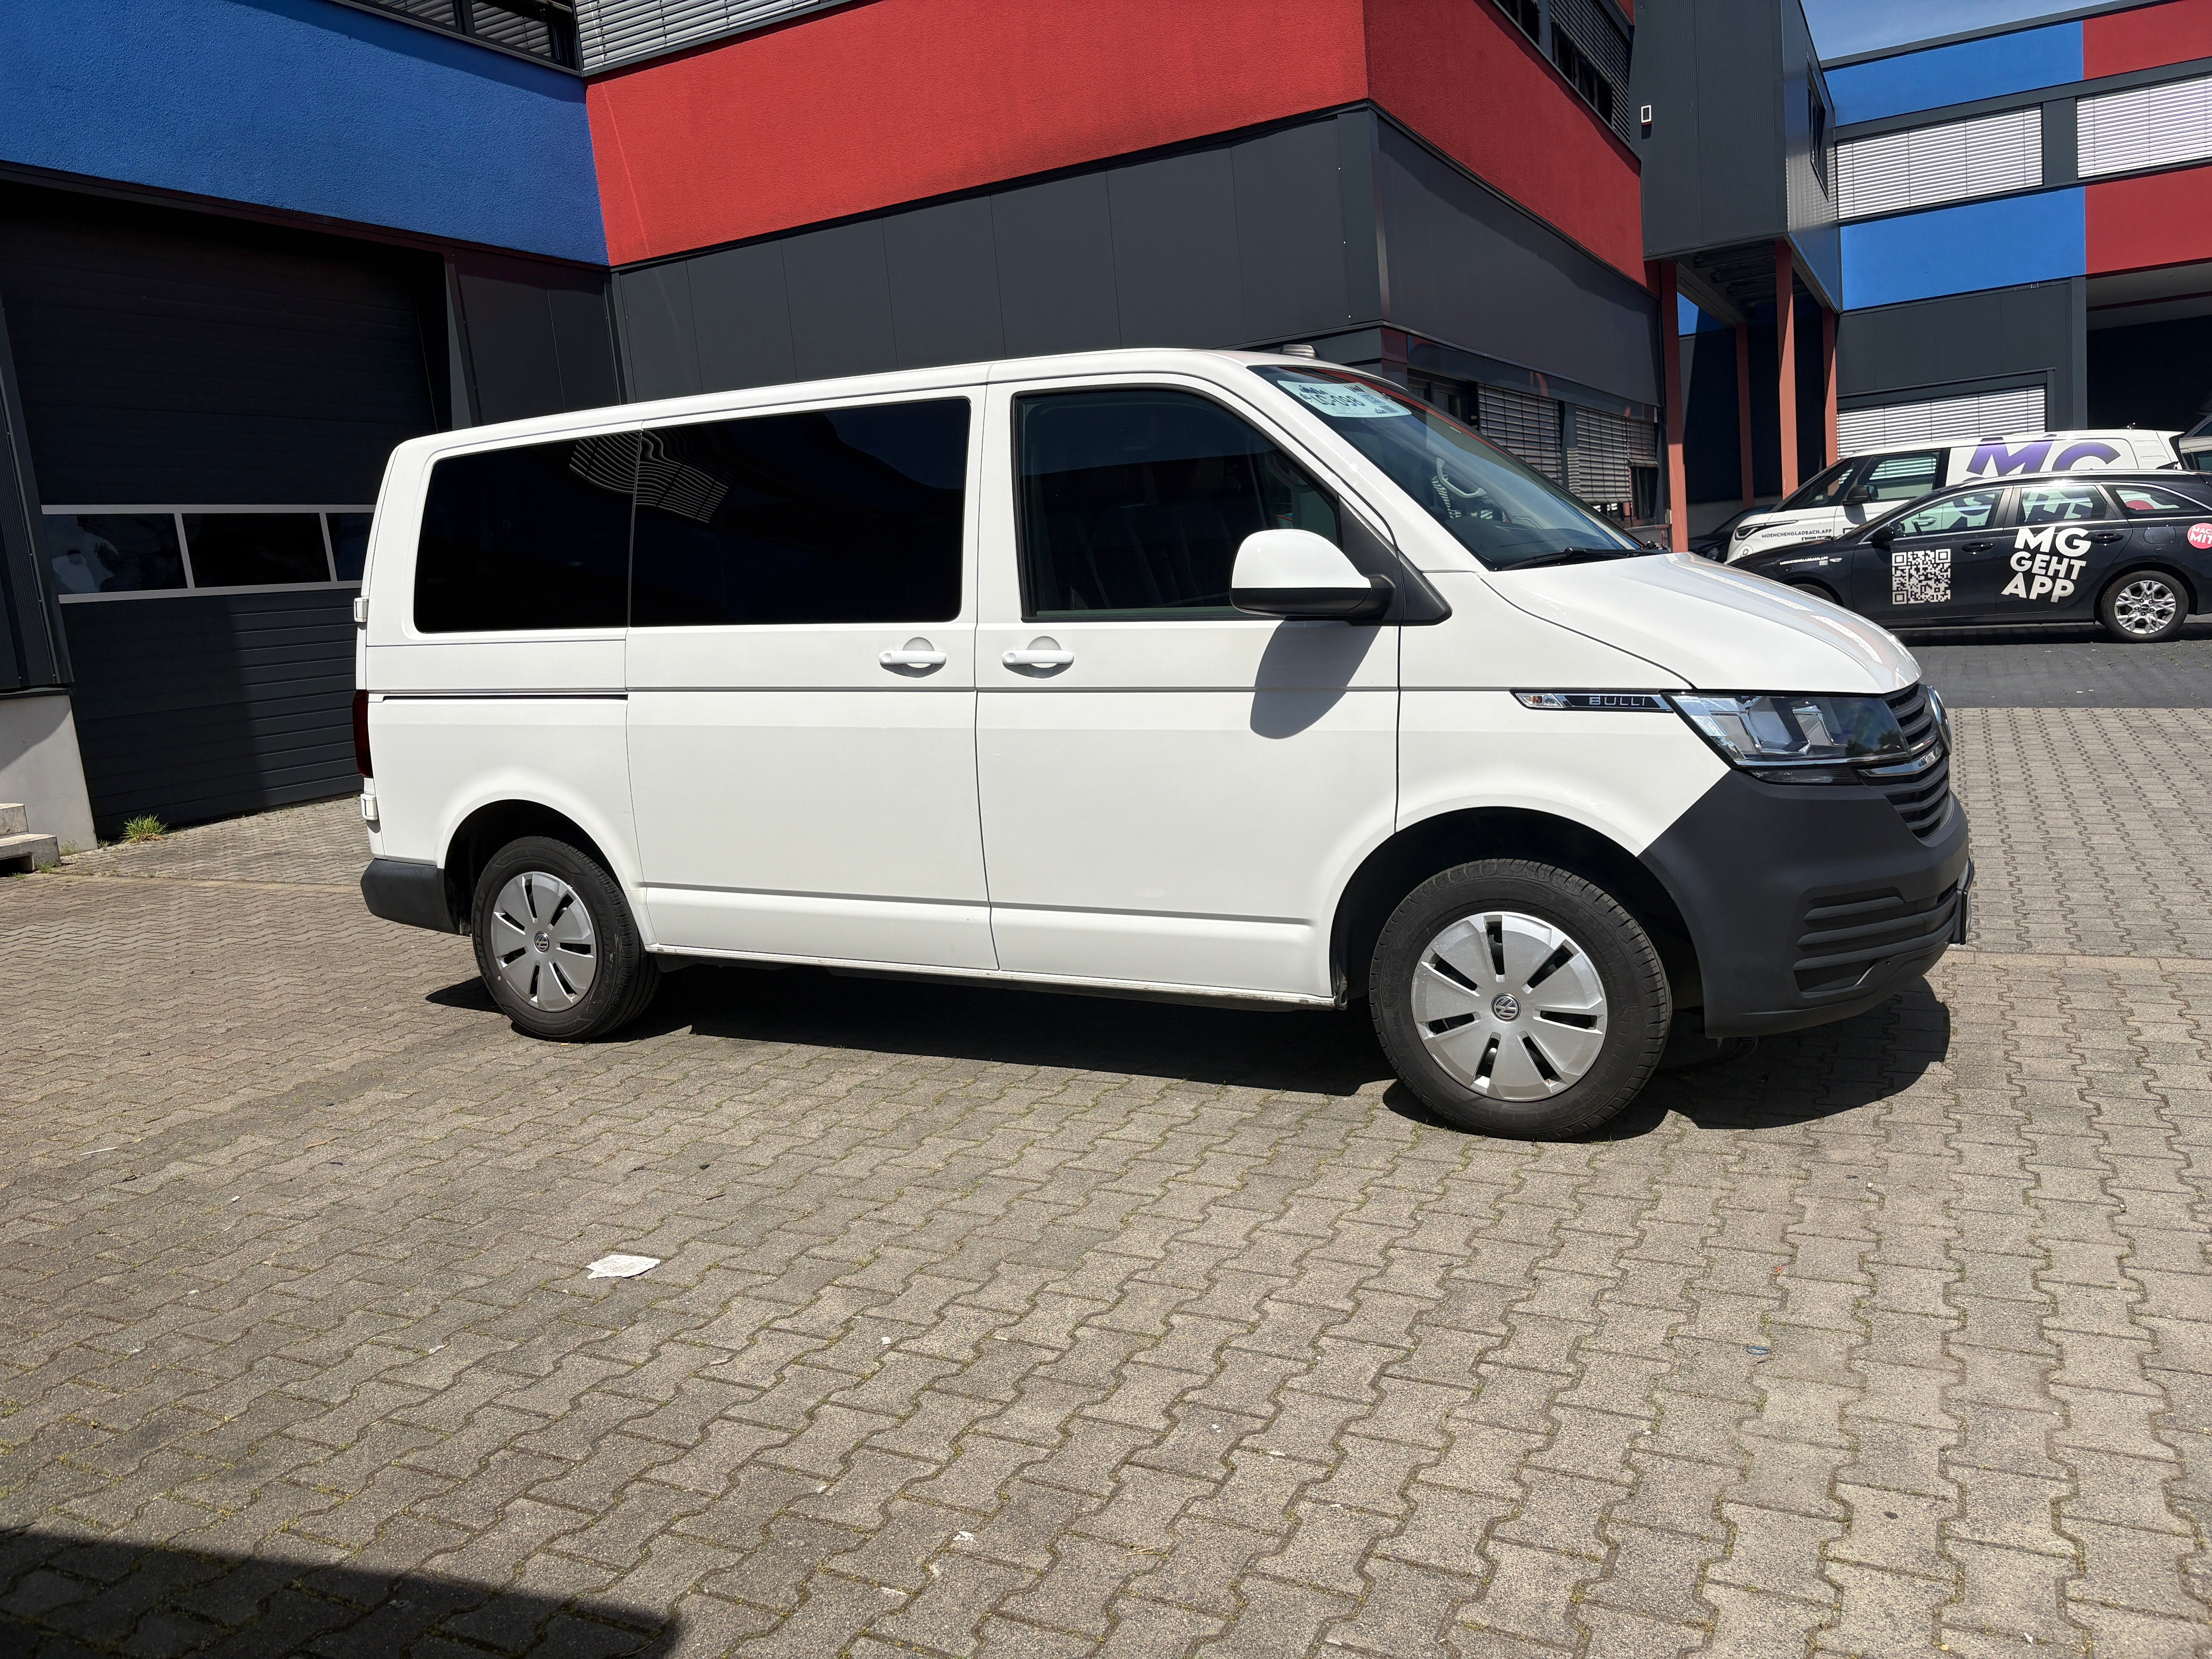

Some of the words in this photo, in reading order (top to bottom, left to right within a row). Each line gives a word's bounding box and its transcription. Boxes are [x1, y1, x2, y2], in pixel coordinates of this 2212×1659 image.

[1311, 394, 1365, 407] LC-098
[1762, 529, 1832, 538] MOENCHENGLADBACH.APP
[2192, 526, 2212, 535] MAC
[2014, 526, 2092, 557] MG
[2010, 551, 2087, 580] GEHT
[2001, 572, 2075, 603] APP
[1589, 696, 1645, 706] BULLI
